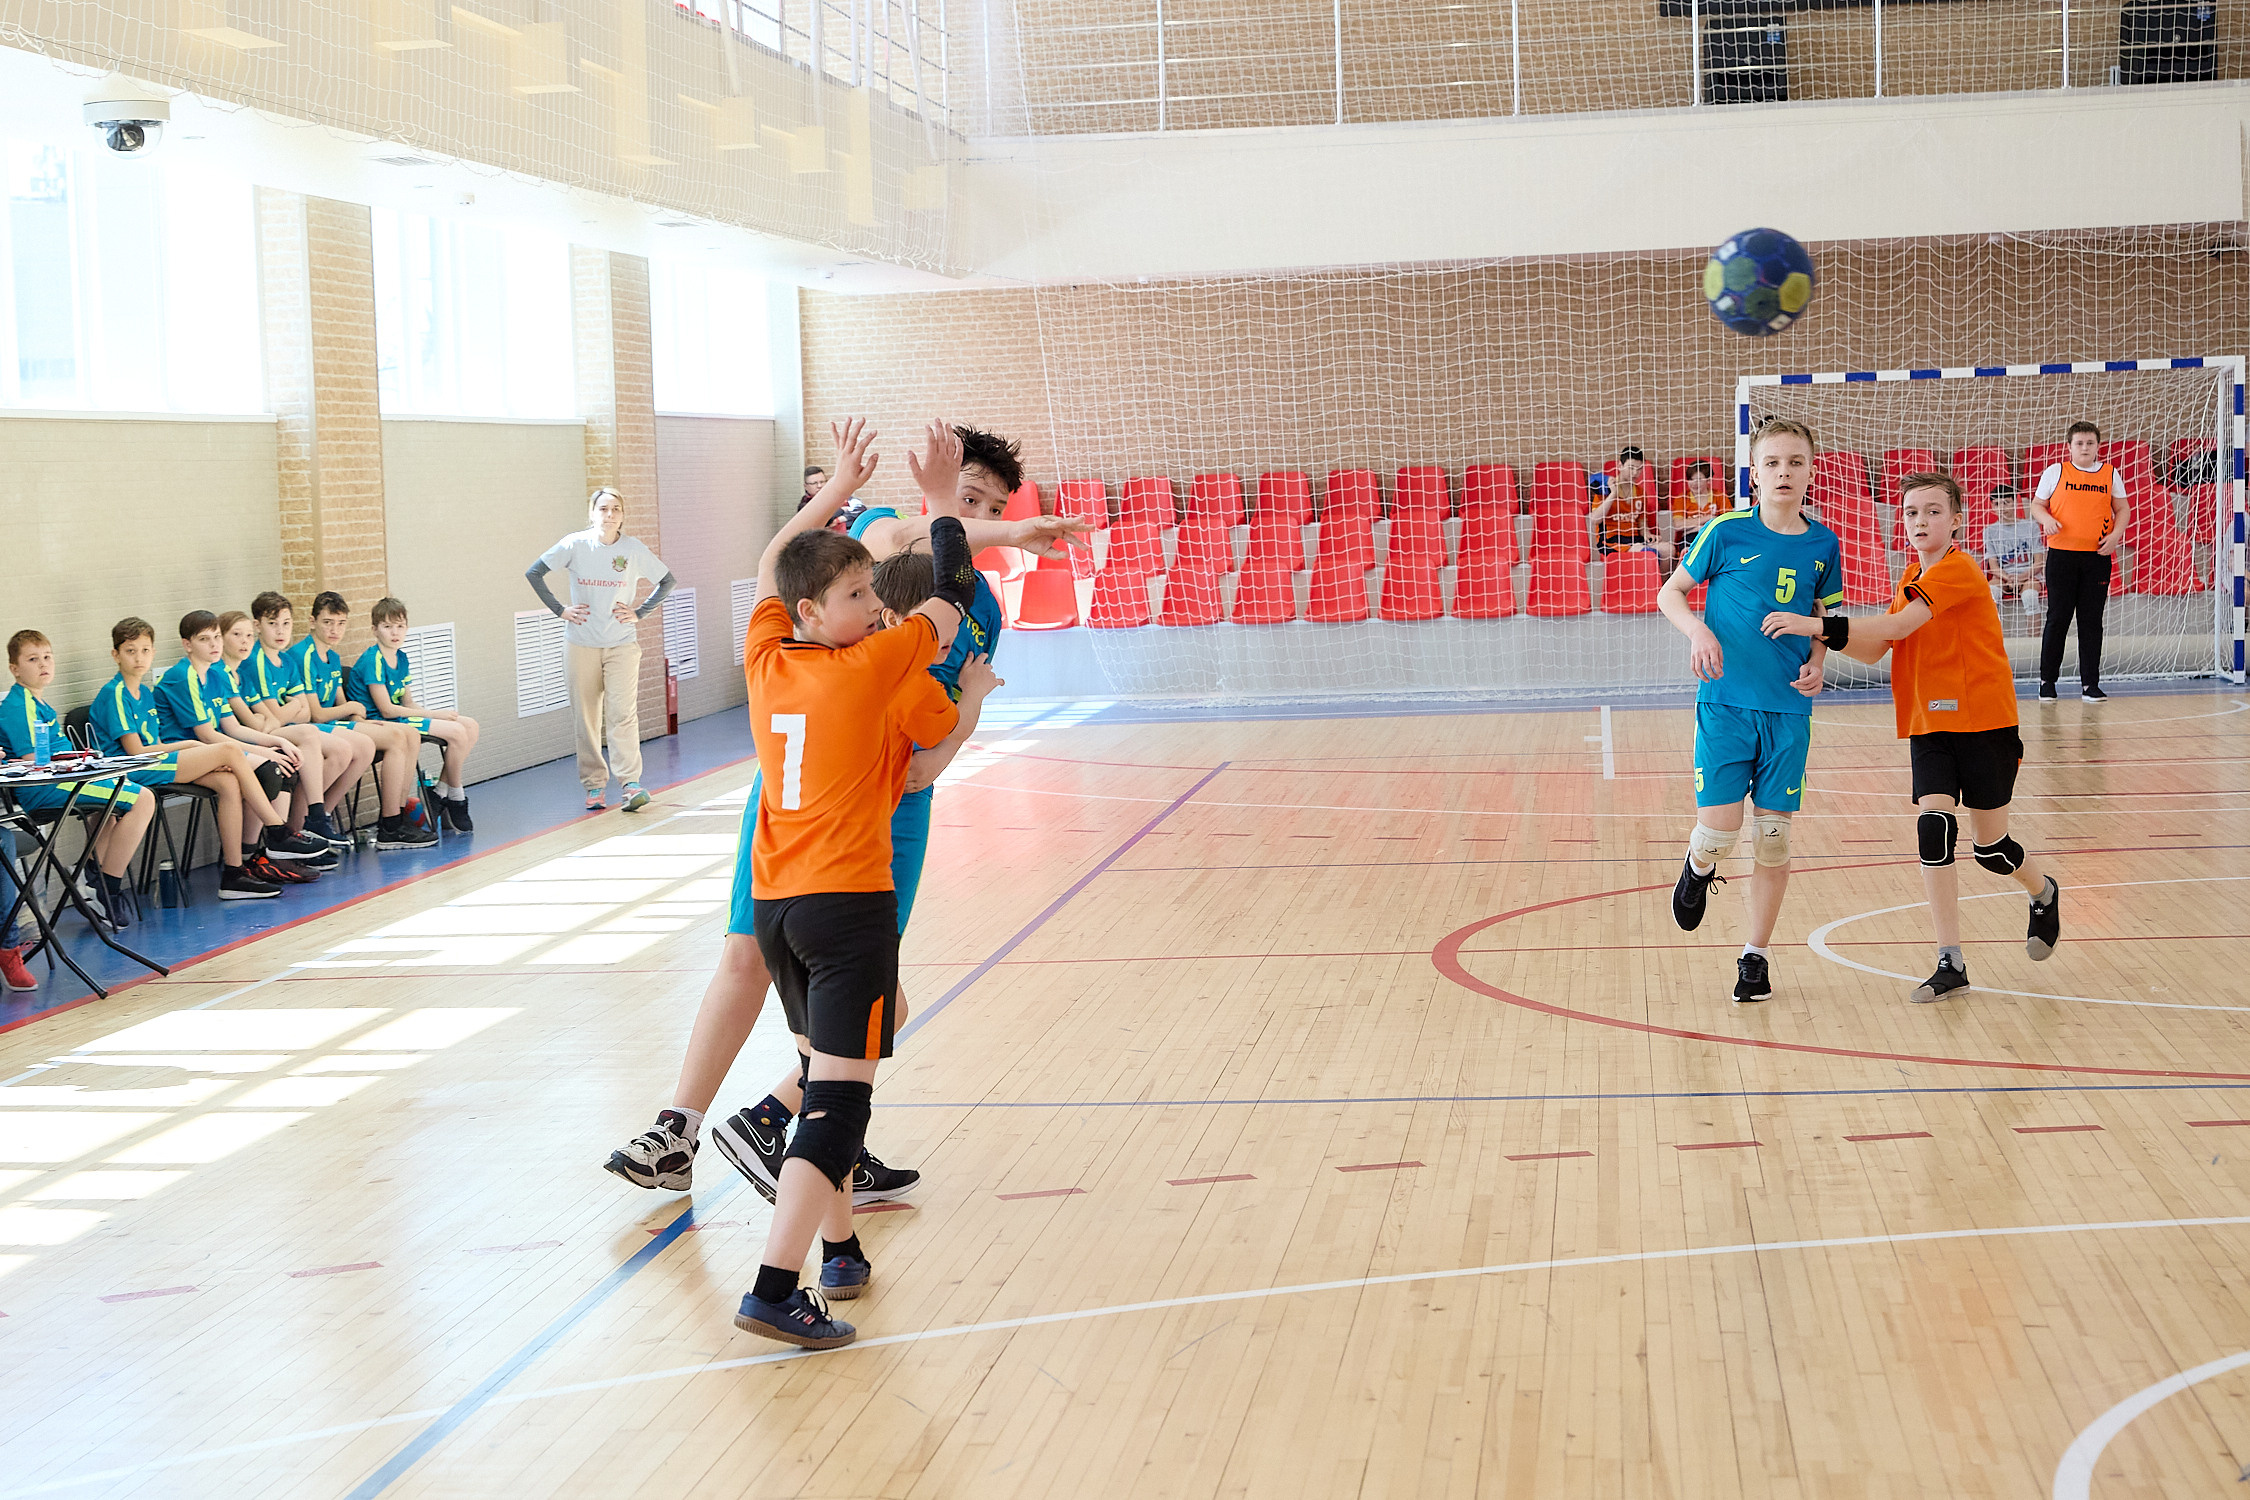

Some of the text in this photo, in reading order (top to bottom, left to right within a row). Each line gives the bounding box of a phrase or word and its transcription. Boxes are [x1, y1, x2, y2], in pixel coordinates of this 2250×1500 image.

[2065, 481, 2108, 494] hummel
[1775, 567, 1797, 604] 5
[1694, 767, 1705, 793] 5
